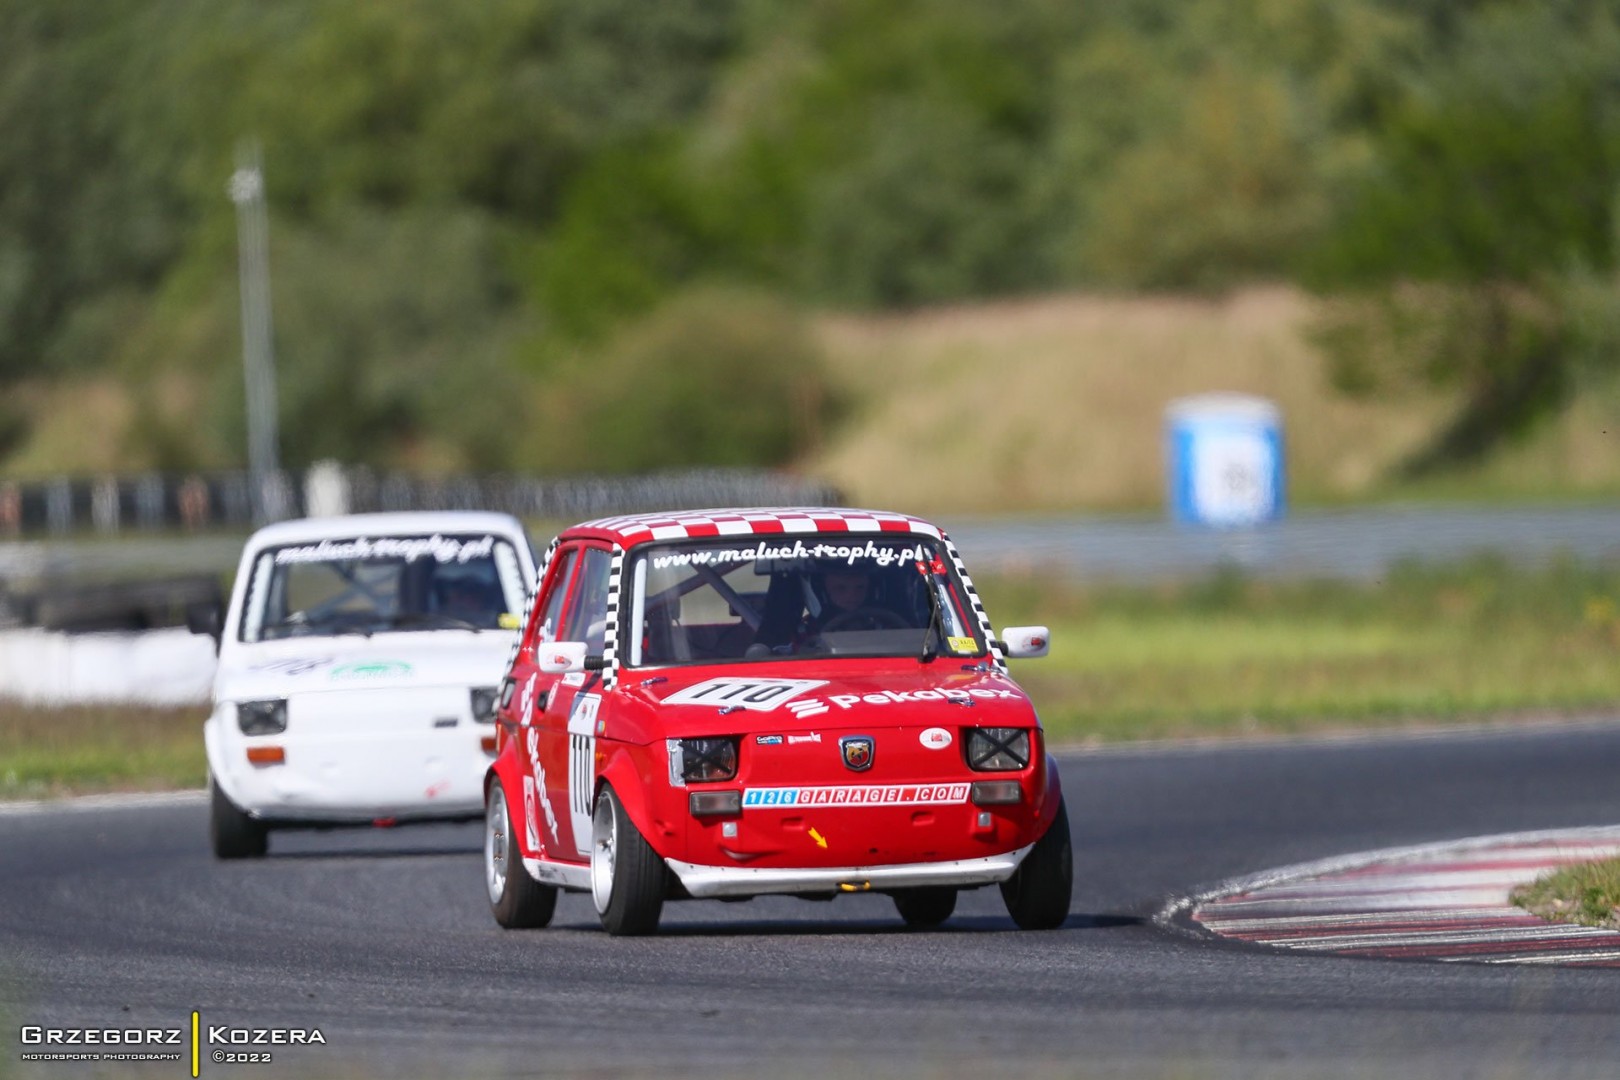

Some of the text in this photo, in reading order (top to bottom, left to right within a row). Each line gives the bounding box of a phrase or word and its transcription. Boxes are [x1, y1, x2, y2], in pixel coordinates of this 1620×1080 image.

[653, 540, 923, 568] www.maluch-trophy.pl
[691, 683, 794, 703] 110
[828, 687, 1023, 709] Pekabex
[572, 734, 592, 817] 110
[748, 786, 964, 804] 126GARAGE.COM
